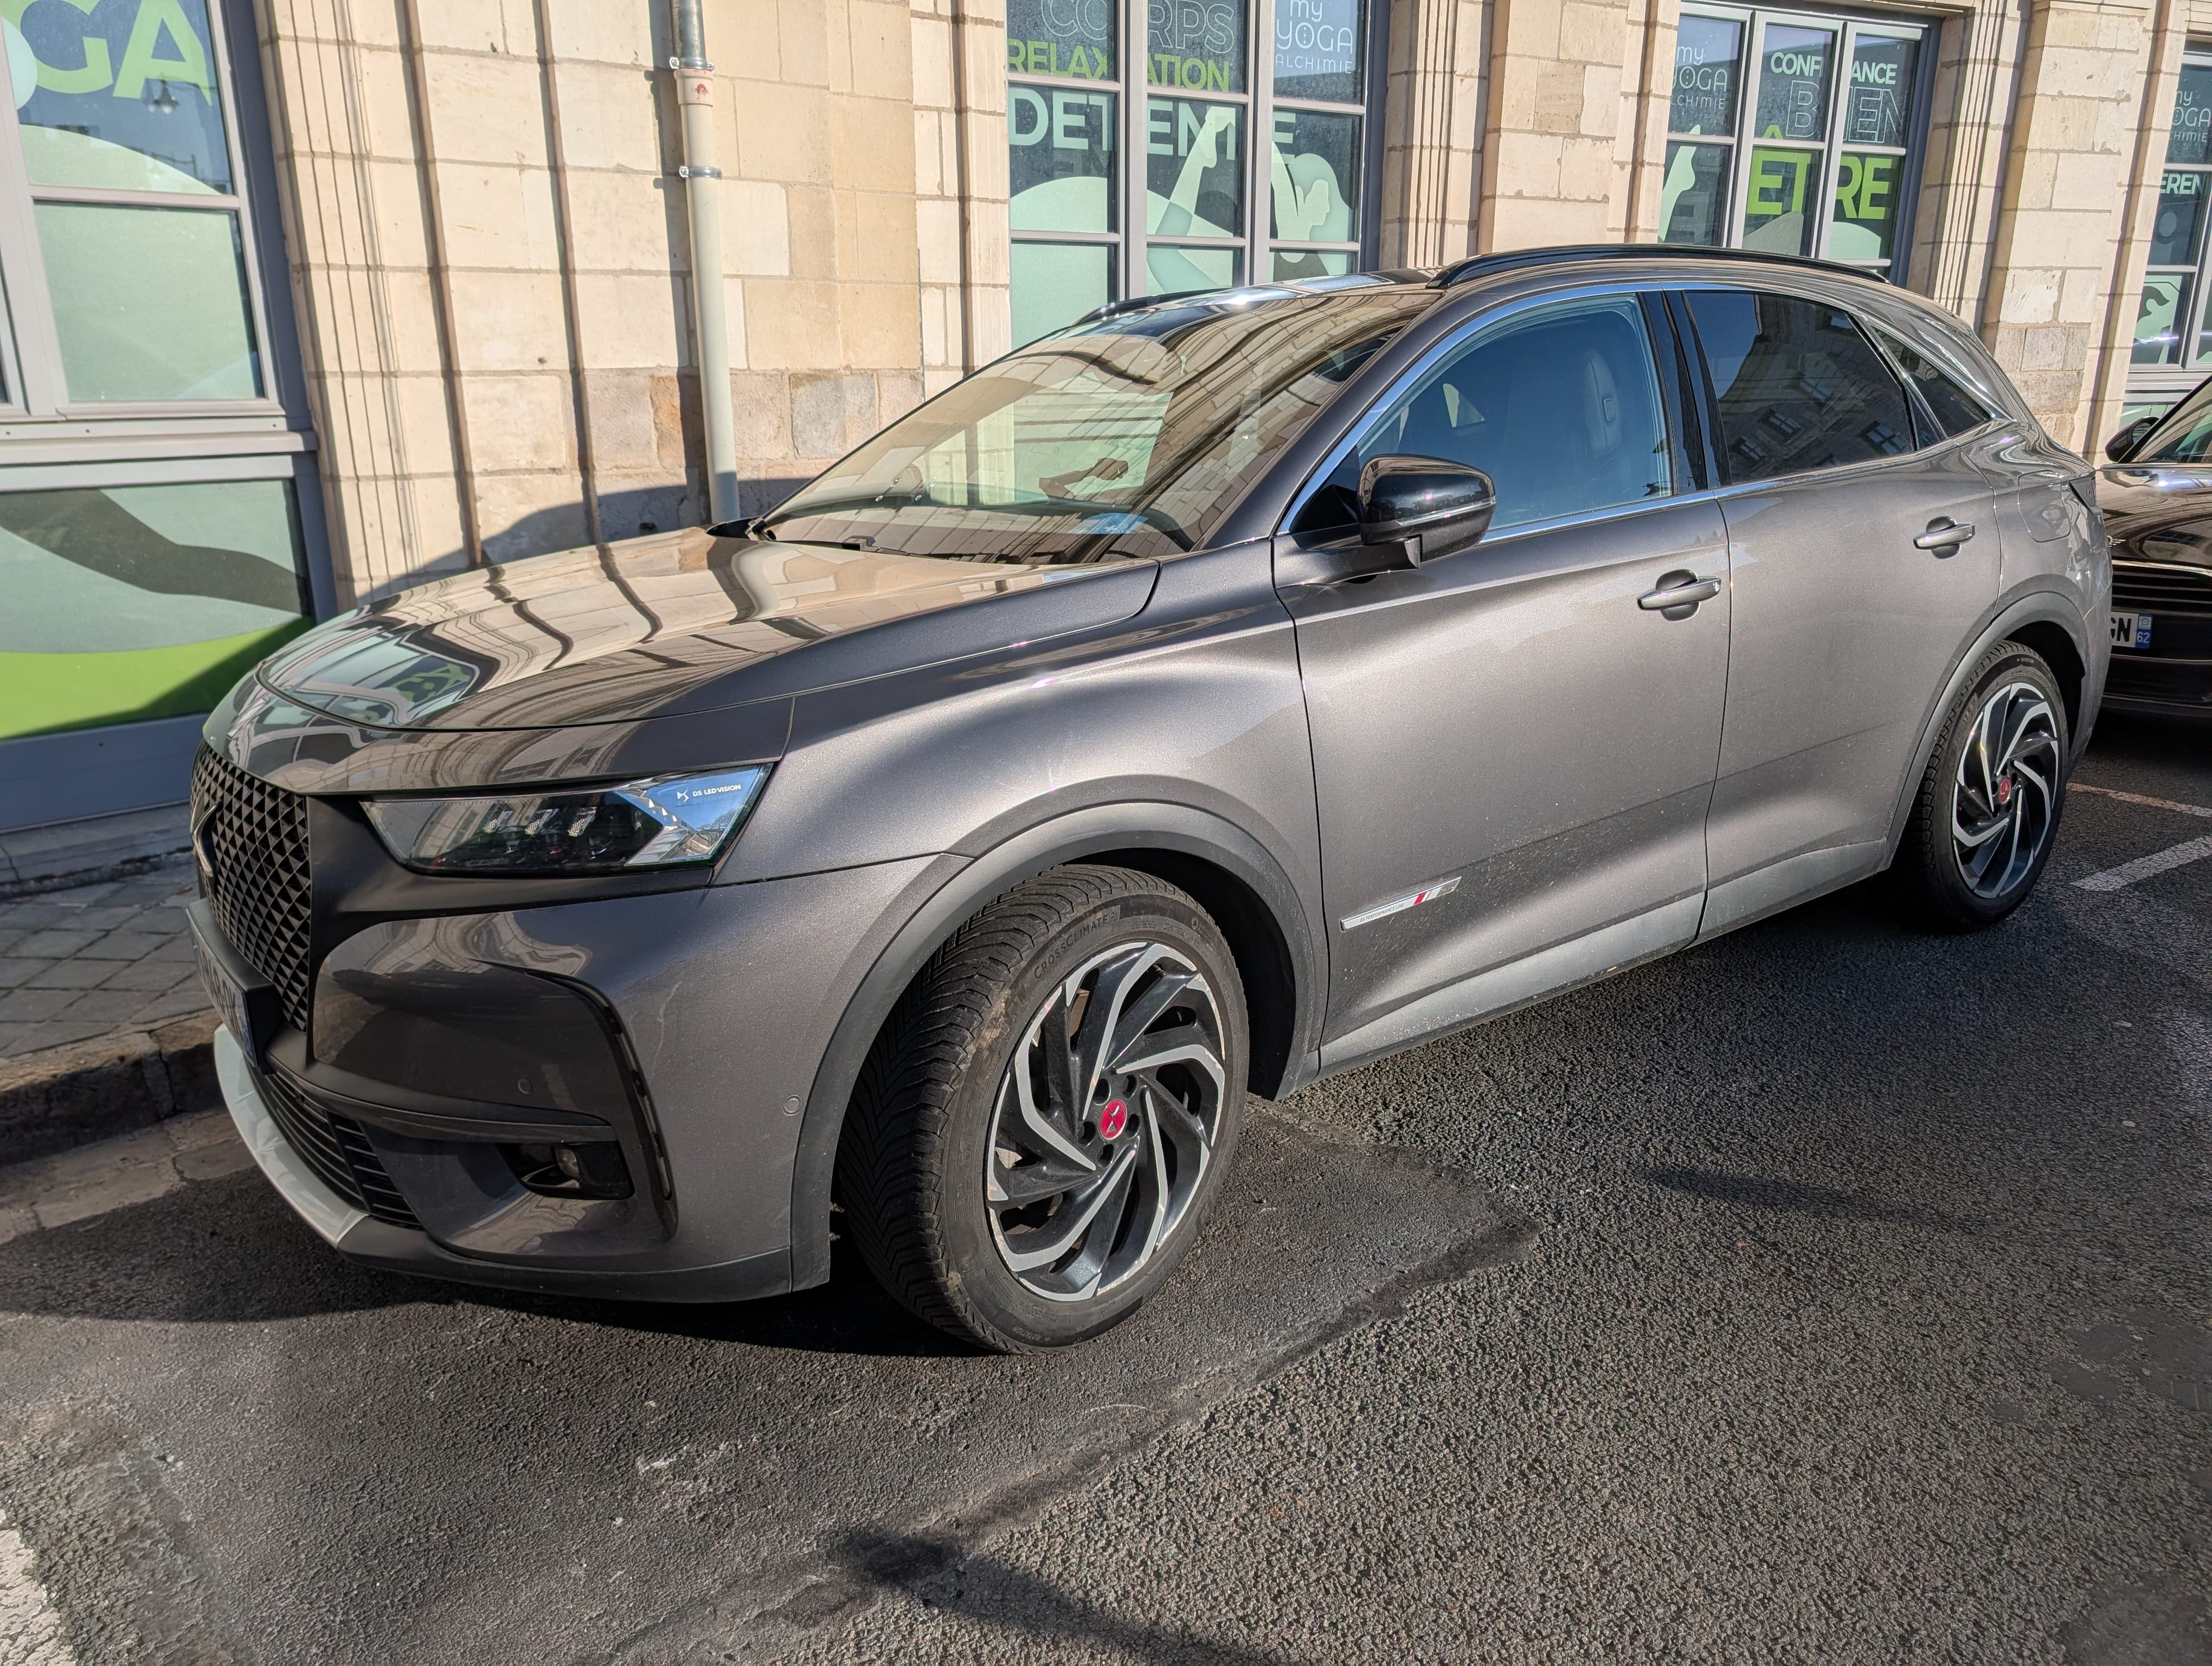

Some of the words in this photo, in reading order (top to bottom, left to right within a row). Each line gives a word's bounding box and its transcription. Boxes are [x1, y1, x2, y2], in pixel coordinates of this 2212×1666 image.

[1290, 0, 1322, 22] my
[1276, 18, 1353, 54] YOGA
[1275, 54, 1353, 74] ALCHIMIE
[1676, 46, 1704, 66] my
[1670, 95, 1726, 109] LCHIMIE
[2171, 106, 2212, 127] OGA
[2169, 131, 2208, 142] CHIMIE
[2137, 632, 2150, 643] 62
[717, 784, 741, 793] VISION
[1366, 906, 1395, 920] PERFORMANCE
[1034, 915, 1108, 979] CROSSCLIMATE
[1012, 1325, 1044, 1341] ROTATION
